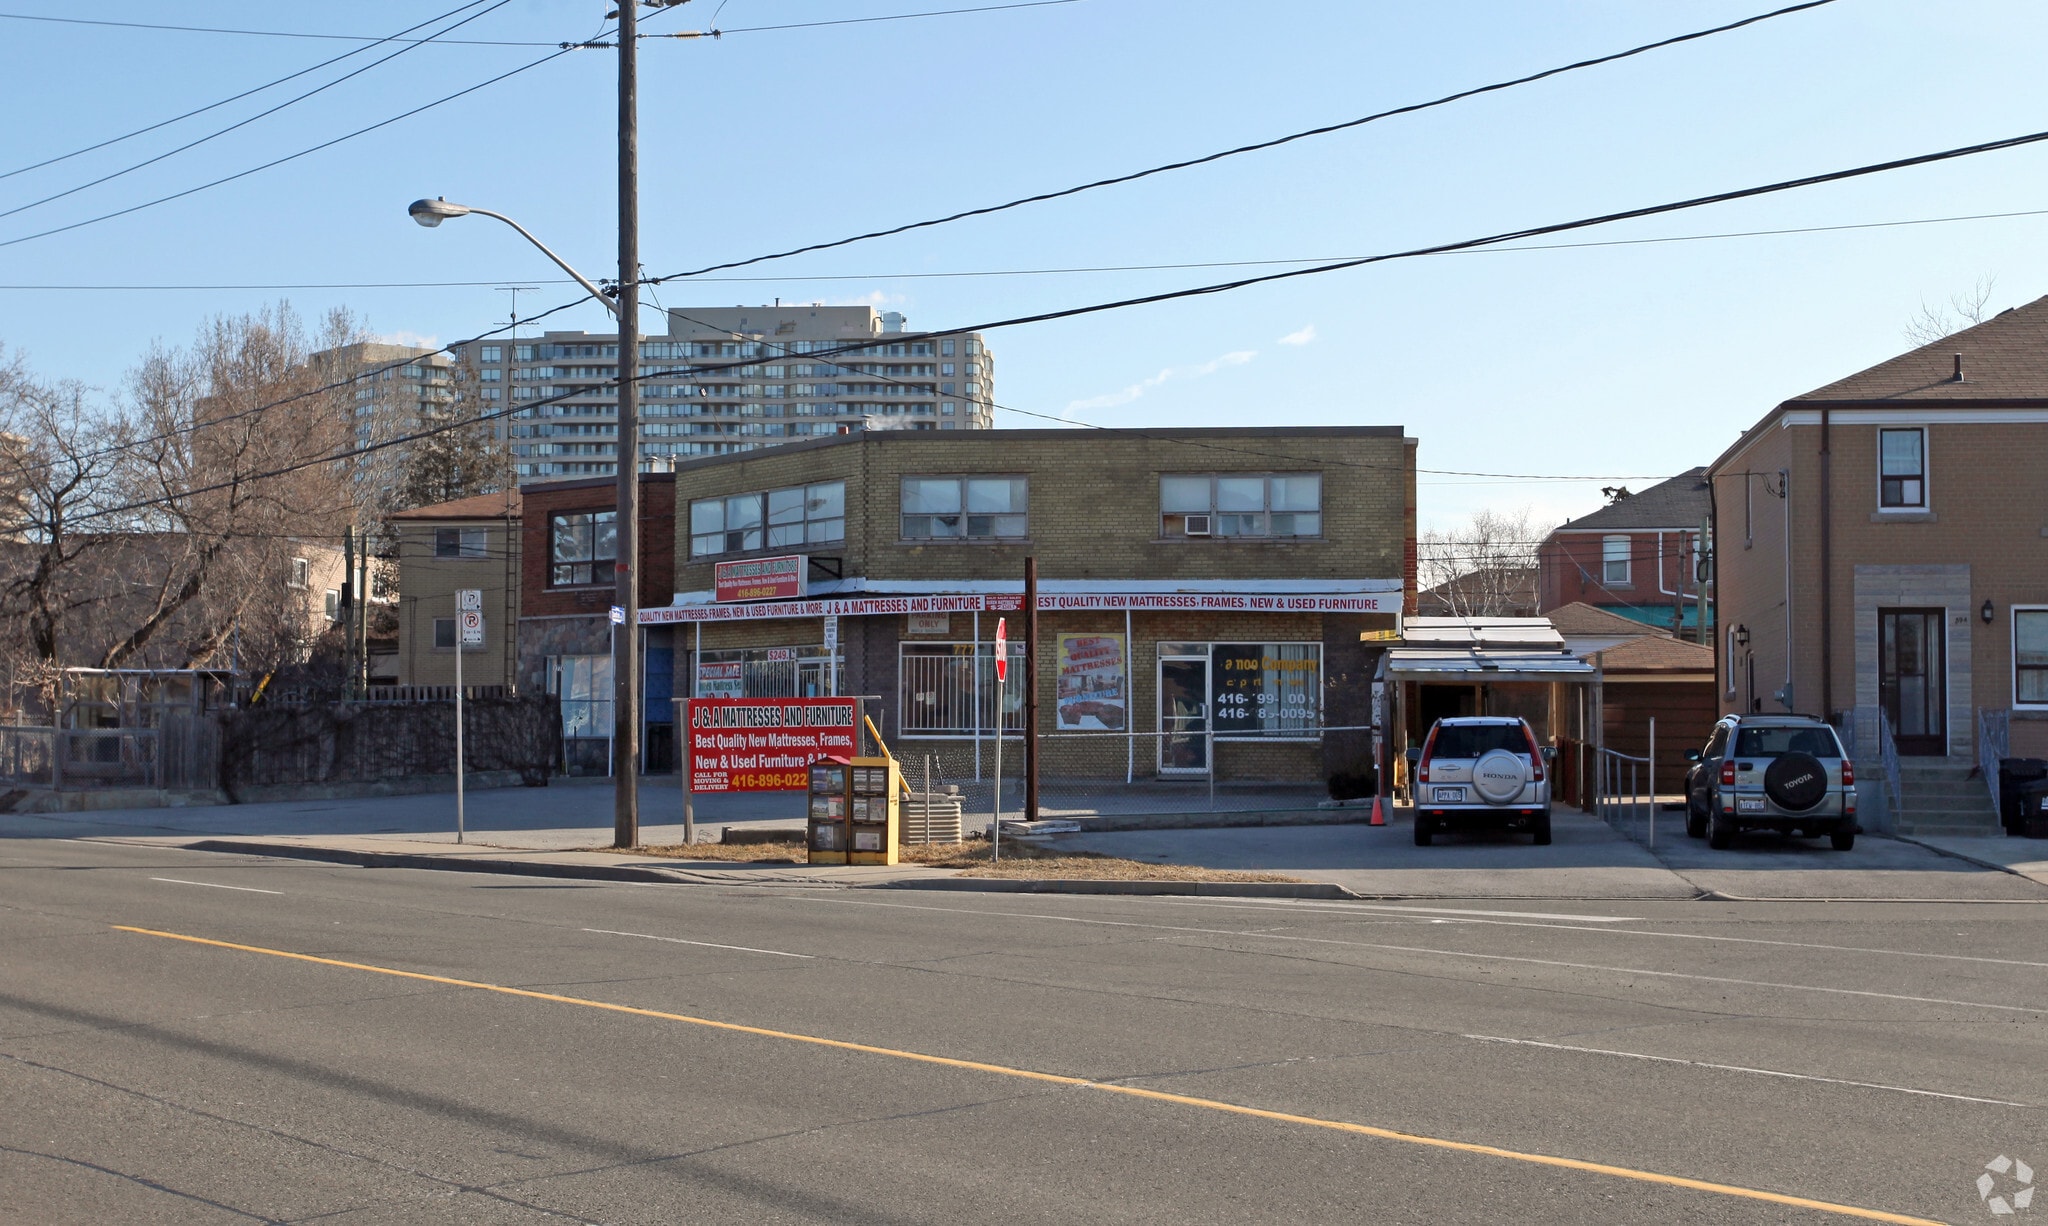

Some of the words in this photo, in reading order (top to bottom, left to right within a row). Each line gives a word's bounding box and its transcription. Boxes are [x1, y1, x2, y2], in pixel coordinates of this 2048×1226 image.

[732, 562, 760, 578] MATTRESSES
[762, 561, 772, 575] AND
[772, 559, 797, 575] FURNITURE
[737, 586, 776, 598] 416-896-0227
[827, 602, 832, 614] J
[834, 601, 840, 614] &
[843, 601, 849, 614] A
[852, 600, 908, 614] MATTRESSES
[911, 599, 929, 612] AND
[931, 597, 981, 611] FURNITURE
[1038, 597, 1056, 607] EST
[1058, 596, 1101, 608] QUALITY
[1104, 596, 1125, 606] NEW
[1129, 596, 1199, 607] MATTRESSES,
[1201, 597, 1247, 608] FRAMES,
[1250, 598, 1274, 608] NEW
[1276, 598, 1284, 608] &
[1287, 598, 1315, 609] USED
[1319, 599, 1378, 610] FURNITURE
[640, 611, 660, 622] QUALITY
[662, 610, 674, 620] NEW
[709, 607, 731, 620] FRAMES,
[733, 606, 745, 618] NEW
[746, 606, 750, 617] &
[751, 605, 766, 617] USED
[767, 604, 799, 616] FURNITURE
[800, 604, 805, 614] &
[806, 602, 822, 614] MORE
[1076, 636, 1101, 647] BEST
[769, 650, 788, 661] $249.
[1070, 646, 1110, 661] QUALITY
[1062, 656, 1122, 675] MATTRESSES
[1262, 656, 1318, 674] Company
[693, 707, 700, 728] J
[702, 707, 711, 728] &
[713, 707, 722, 728] A
[722, 706, 782, 728] MATTRESSES
[783, 706, 802, 727] AND
[805, 705, 853, 726] FURNITURE
[696, 734, 715, 748] Best
[717, 734, 746, 750] Quality
[749, 734, 766, 747] New
[768, 733, 818, 748] Mattresses,
[820, 732, 852, 748] Frames,
[696, 755, 717, 769] New
[720, 755, 728, 768] &
[731, 754, 756, 768] Used
[759, 754, 804, 768] Furniture
[808, 753, 816, 766] &
[732, 773, 807, 787] 416-896-022
[1784, 773, 1814, 790] TOYOTA
